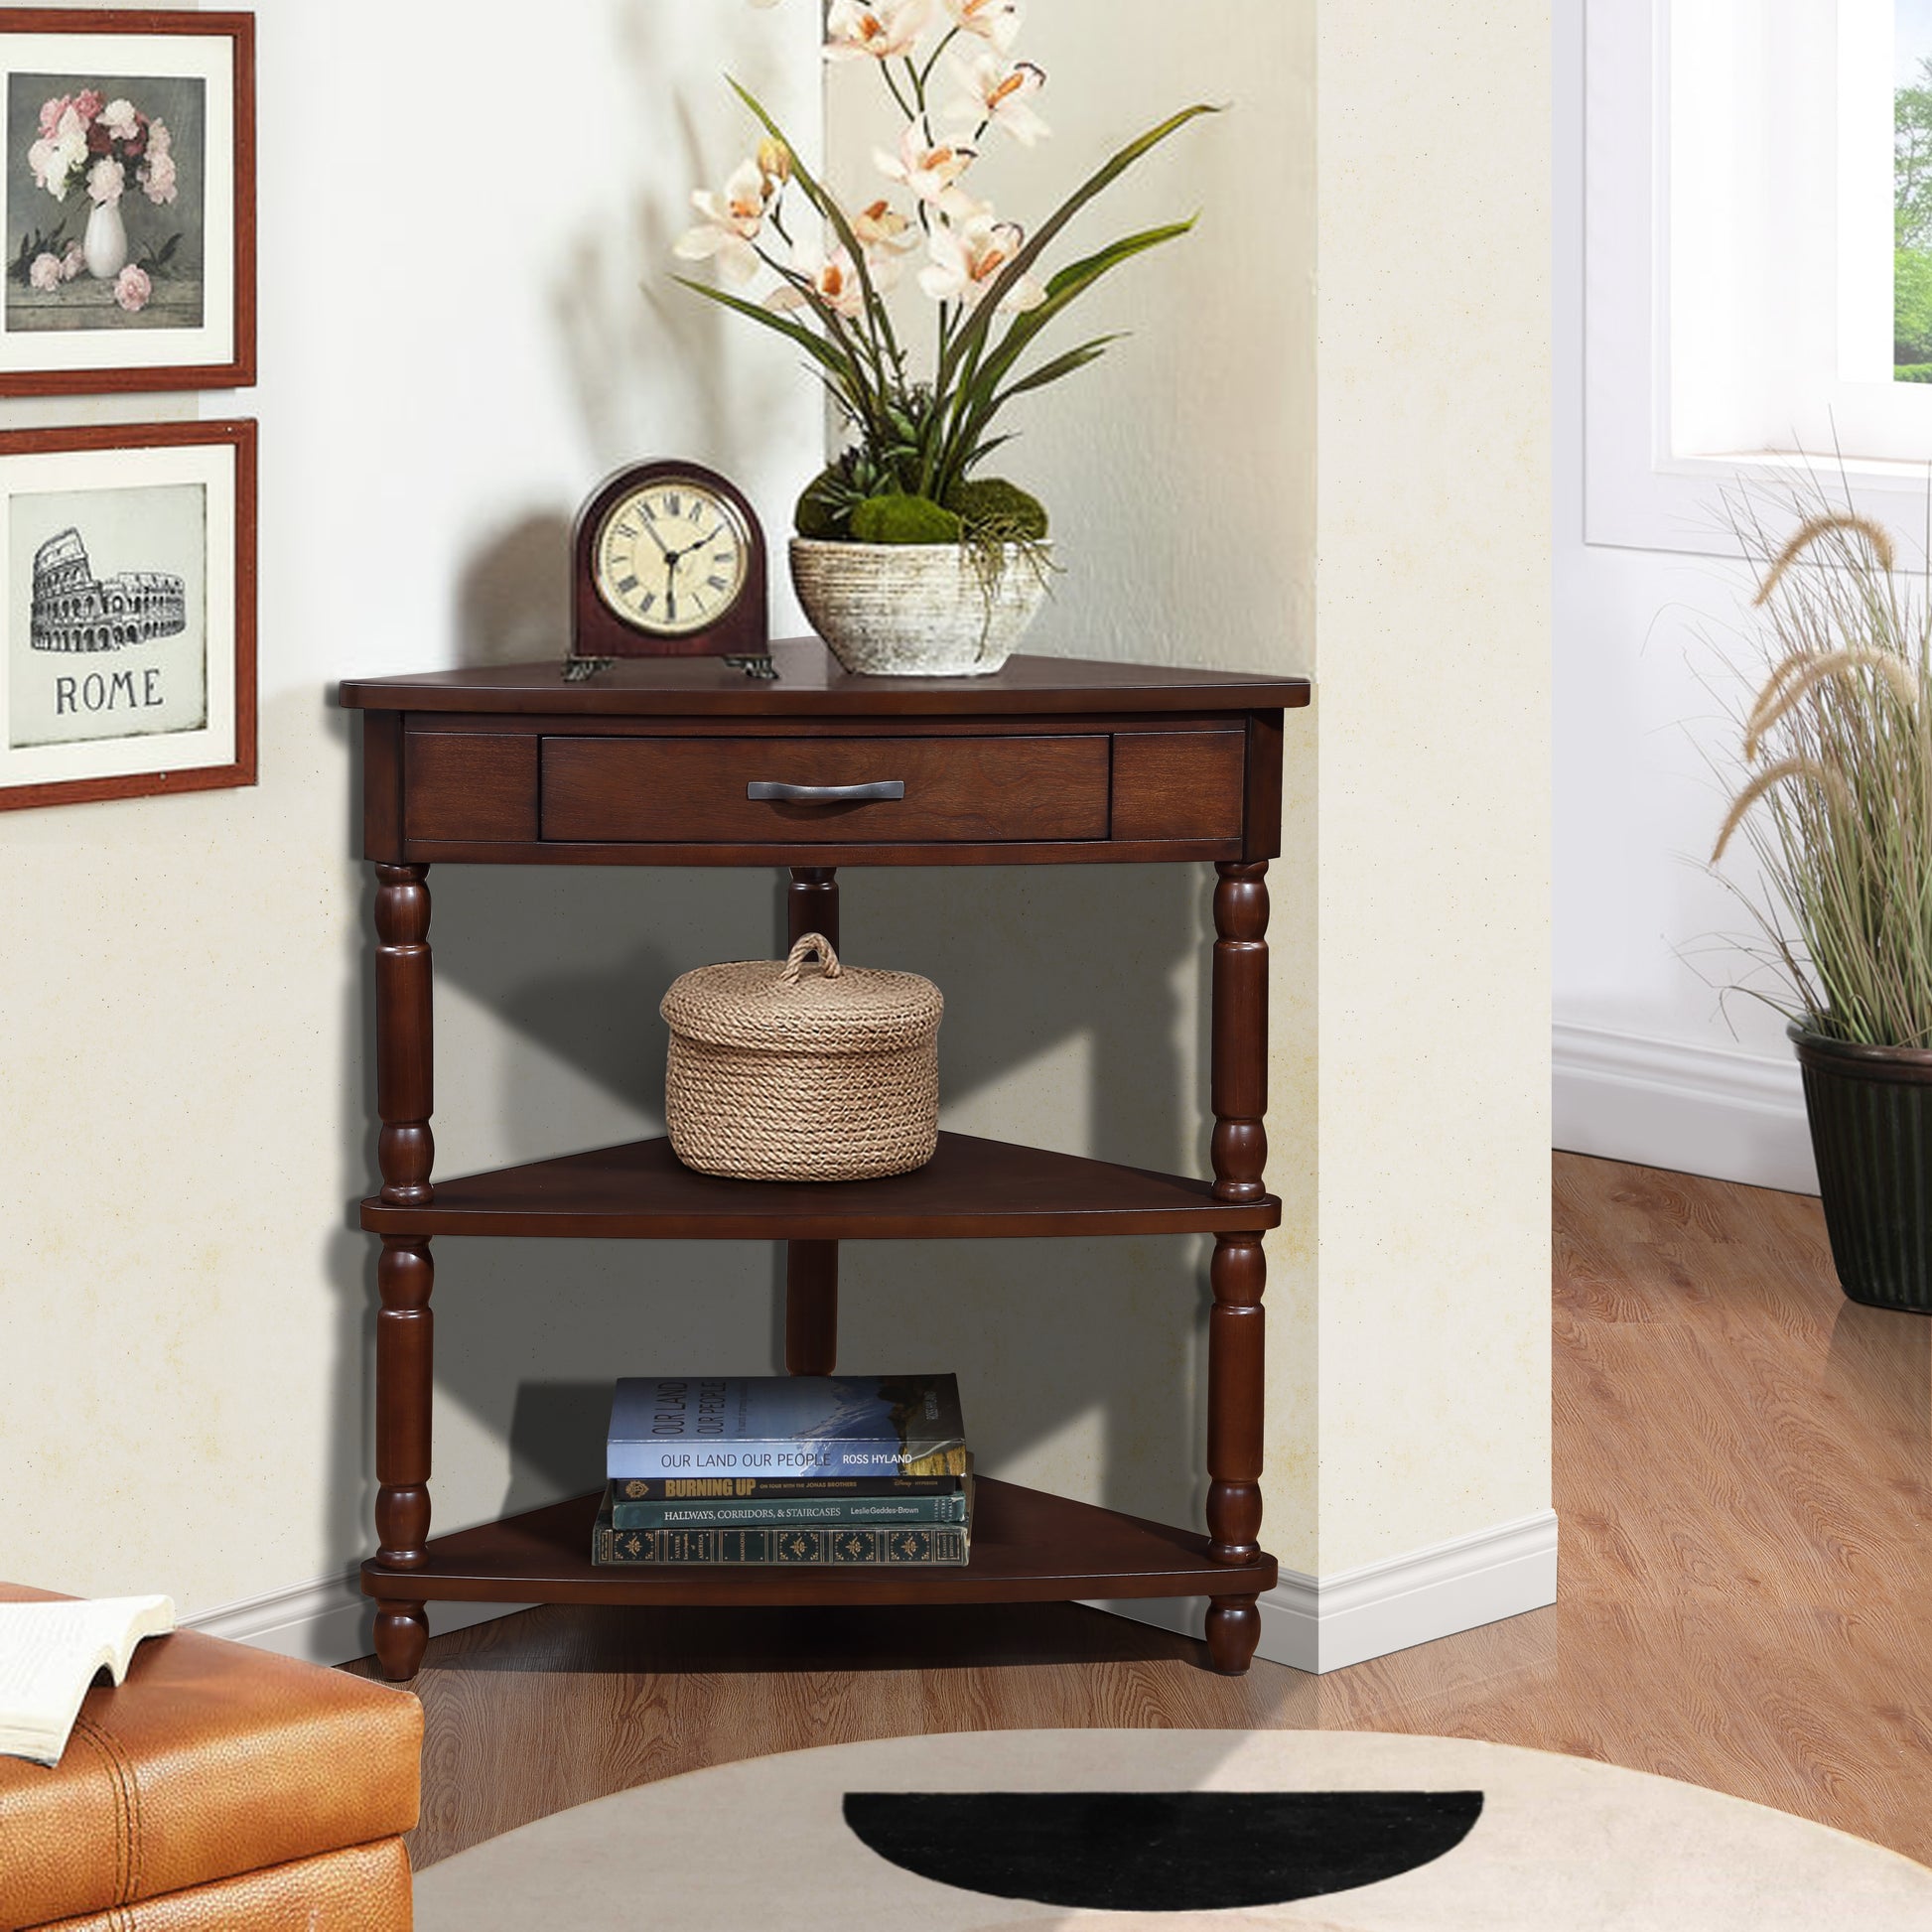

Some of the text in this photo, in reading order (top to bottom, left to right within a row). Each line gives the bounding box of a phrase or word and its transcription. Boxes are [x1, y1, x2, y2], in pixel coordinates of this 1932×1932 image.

[57, 668, 164, 715] ROME
[651, 1381, 688, 1436] OUR LAND
[697, 1381, 726, 1435] OUR PEOPLE
[660, 1452, 831, 1467] OUR LAND OUR PEOPLE
[842, 1453, 912, 1464] ROSS HYLAND
[665, 1477, 757, 1497] BURNING UP
[664, 1507, 841, 1521] HALLWAYS, CORRIDORS, & STAIRCASES
